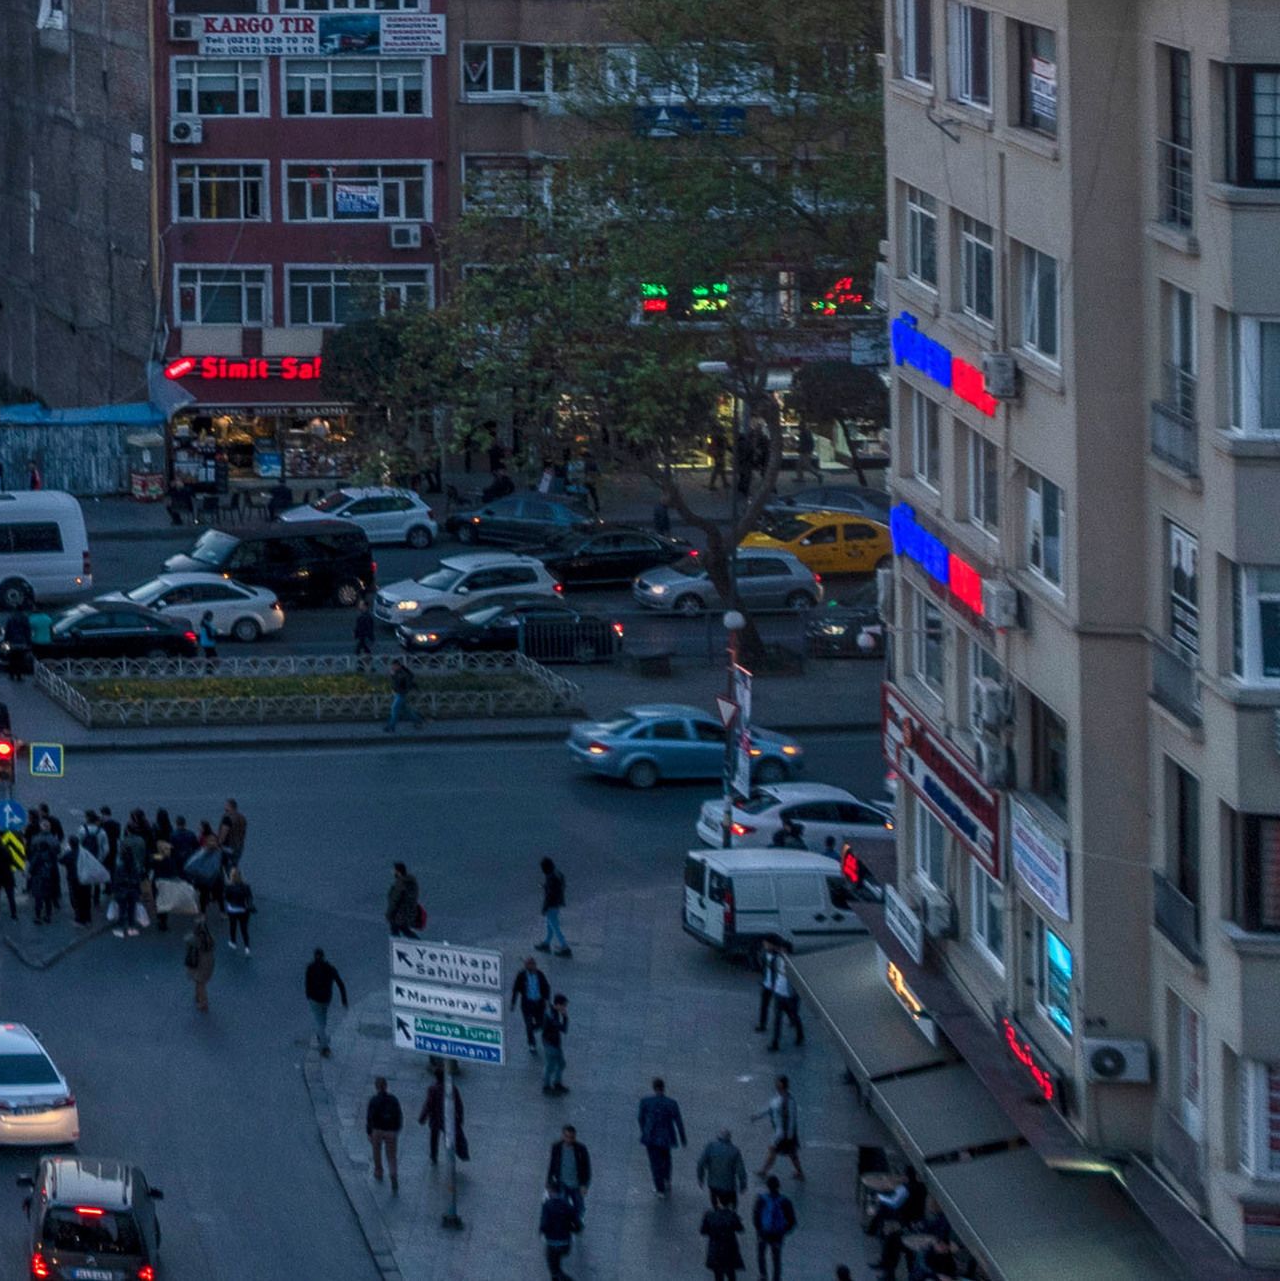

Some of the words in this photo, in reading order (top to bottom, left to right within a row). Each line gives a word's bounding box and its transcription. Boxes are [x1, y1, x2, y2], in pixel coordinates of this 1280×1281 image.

[203, 17, 274, 34] KARGO
[279, 17, 317, 34] TIR
[227, 36, 261, 45] (0212)
[228, 46, 261, 55] (0212)
[201, 355, 270, 380] Simit
[416, 947, 499, 972] Yenikapı
[415, 963, 499, 986] Sahilyolu
[406, 989, 478, 1013] Marmaray
[416, 1018, 461, 1036] Avrasya
[416, 1037, 489, 1058] Havalimanı
